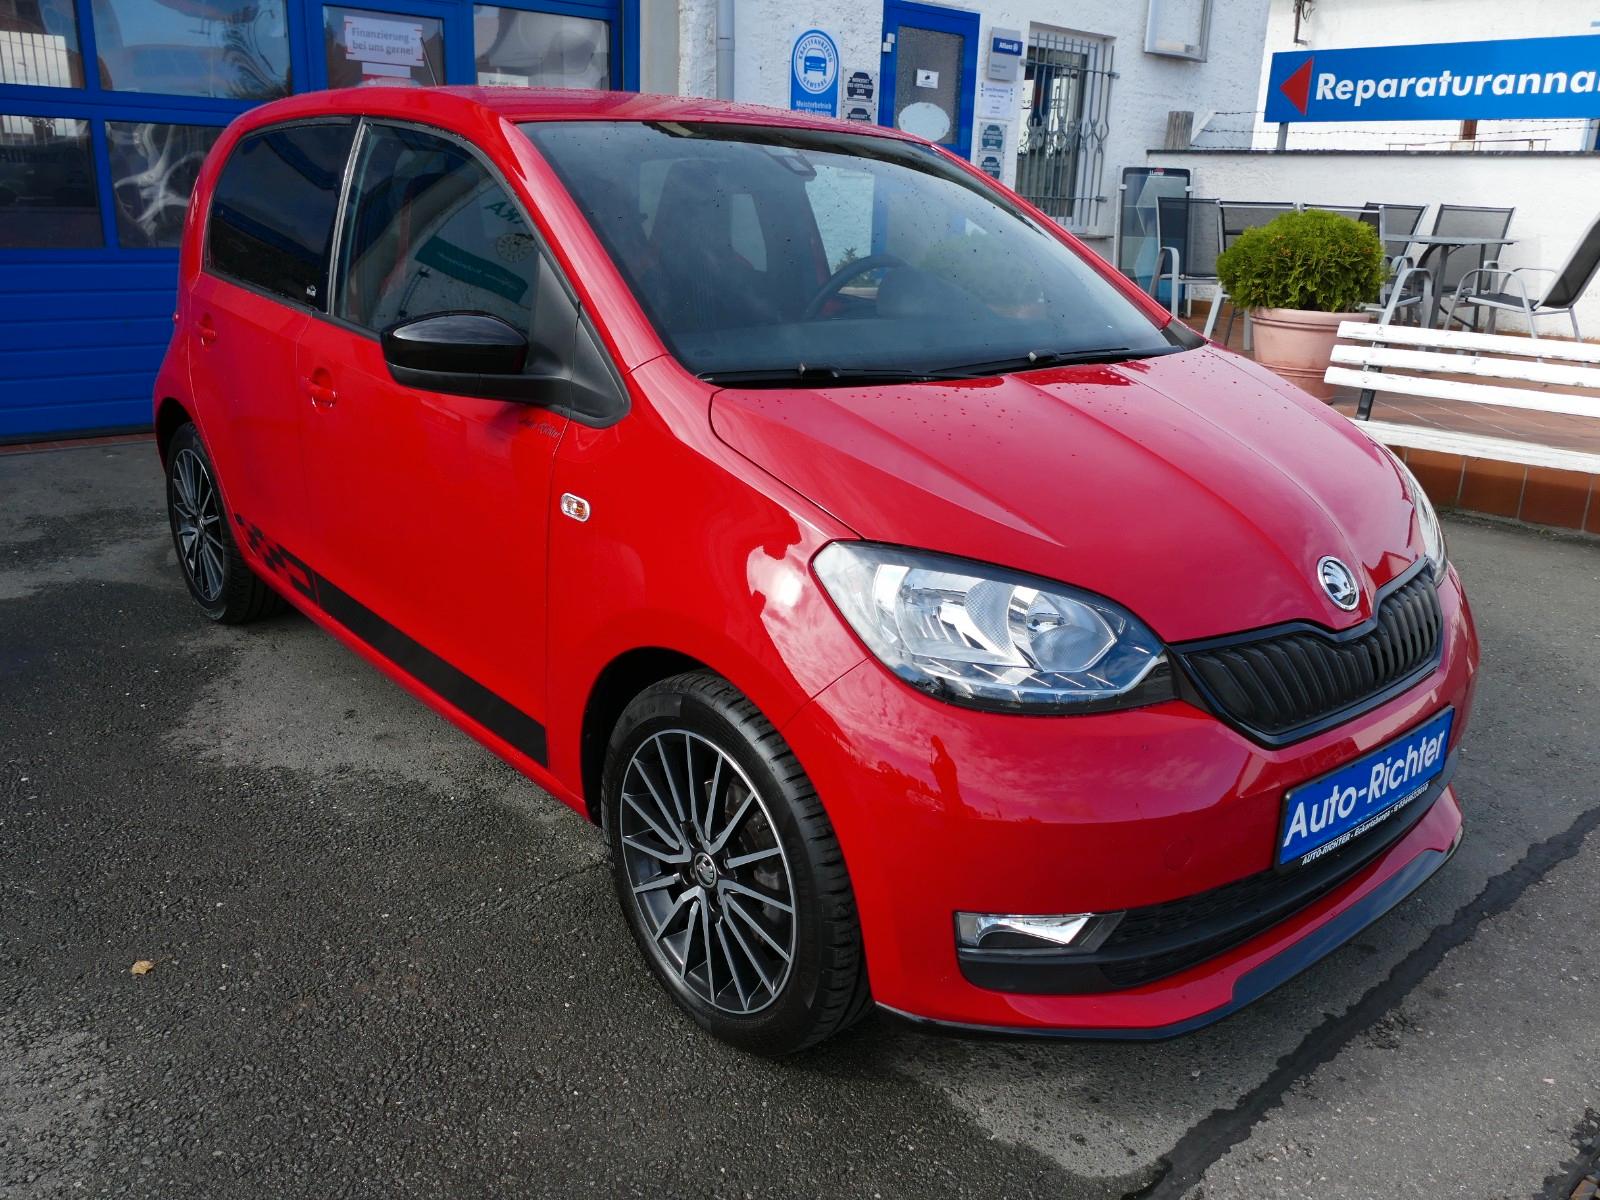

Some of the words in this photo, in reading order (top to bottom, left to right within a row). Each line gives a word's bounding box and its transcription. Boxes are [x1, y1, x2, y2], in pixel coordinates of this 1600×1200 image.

[352, 27, 409, 44] Finanzierung
[353, 39, 367, 50] bei
[368, 43, 385, 52] uns
[385, 45, 414, 57] gerne!
[1316, 70, 1600, 107] Reparaturanna
[1283, 730, 1445, 848] Auto-Richter
